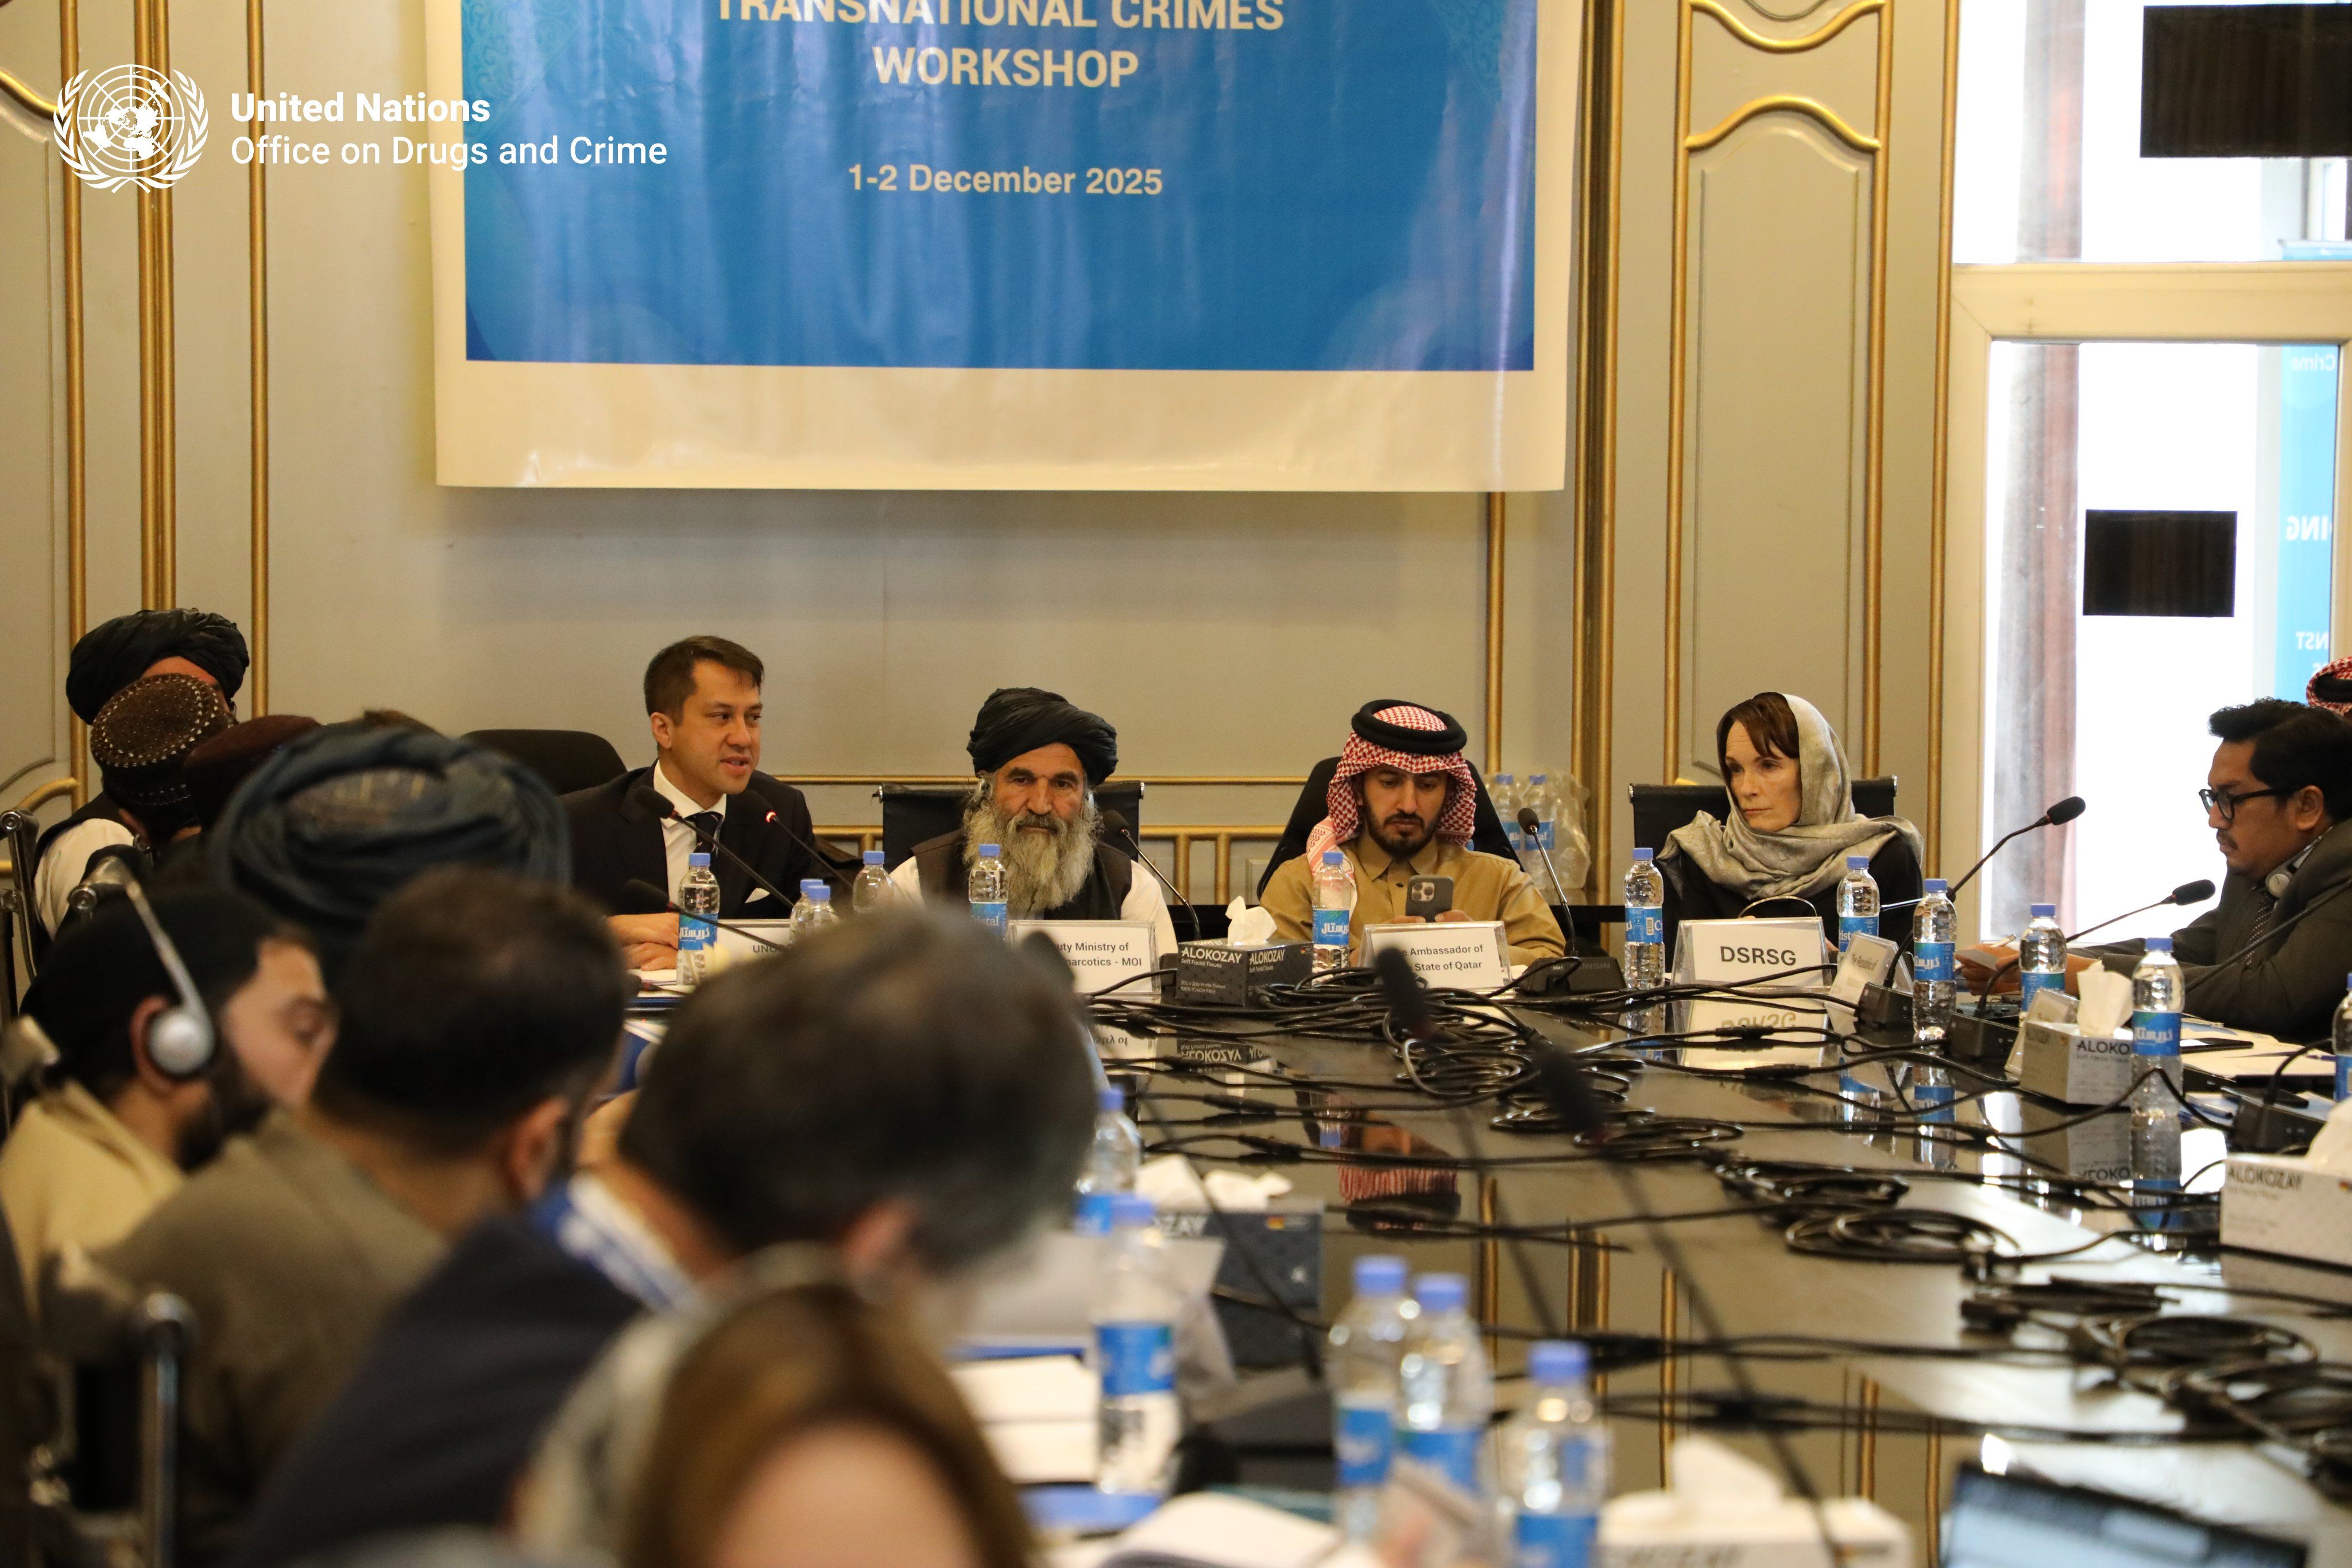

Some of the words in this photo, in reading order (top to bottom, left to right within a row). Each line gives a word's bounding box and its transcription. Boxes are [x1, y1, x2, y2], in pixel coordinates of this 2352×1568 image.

[718, 0, 1097, 27] TRANSNATIONAL
[1112, 0, 1283, 30] CRIMES
[873, 47, 1139, 87] WORKSHOP
[849, 164, 897, 191] 1-2
[910, 165, 1076, 193] December
[1086, 168, 1163, 195] 2025
[1057, 943, 1073, 953] uty
[1076, 942, 1116, 953] Ministry
[1119, 942, 1129, 951] of
[1181, 947, 1242, 964] ALOKOZAY
[1410, 945, 1471, 955] Ambassador
[1474, 944, 1483, 953] of
[1066, 957, 1111, 966] narcotics
[1121, 958, 1142, 966] MOI
[1249, 949, 1286, 965] ALOKOZAY
[1720, 946, 1796, 966] DSRSG
[1415, 963, 1441, 971] State
[1443, 962, 1452, 970] of
[1455, 961, 1482, 971] Qatar
[2076, 1040, 2130, 1055] ALOKO
